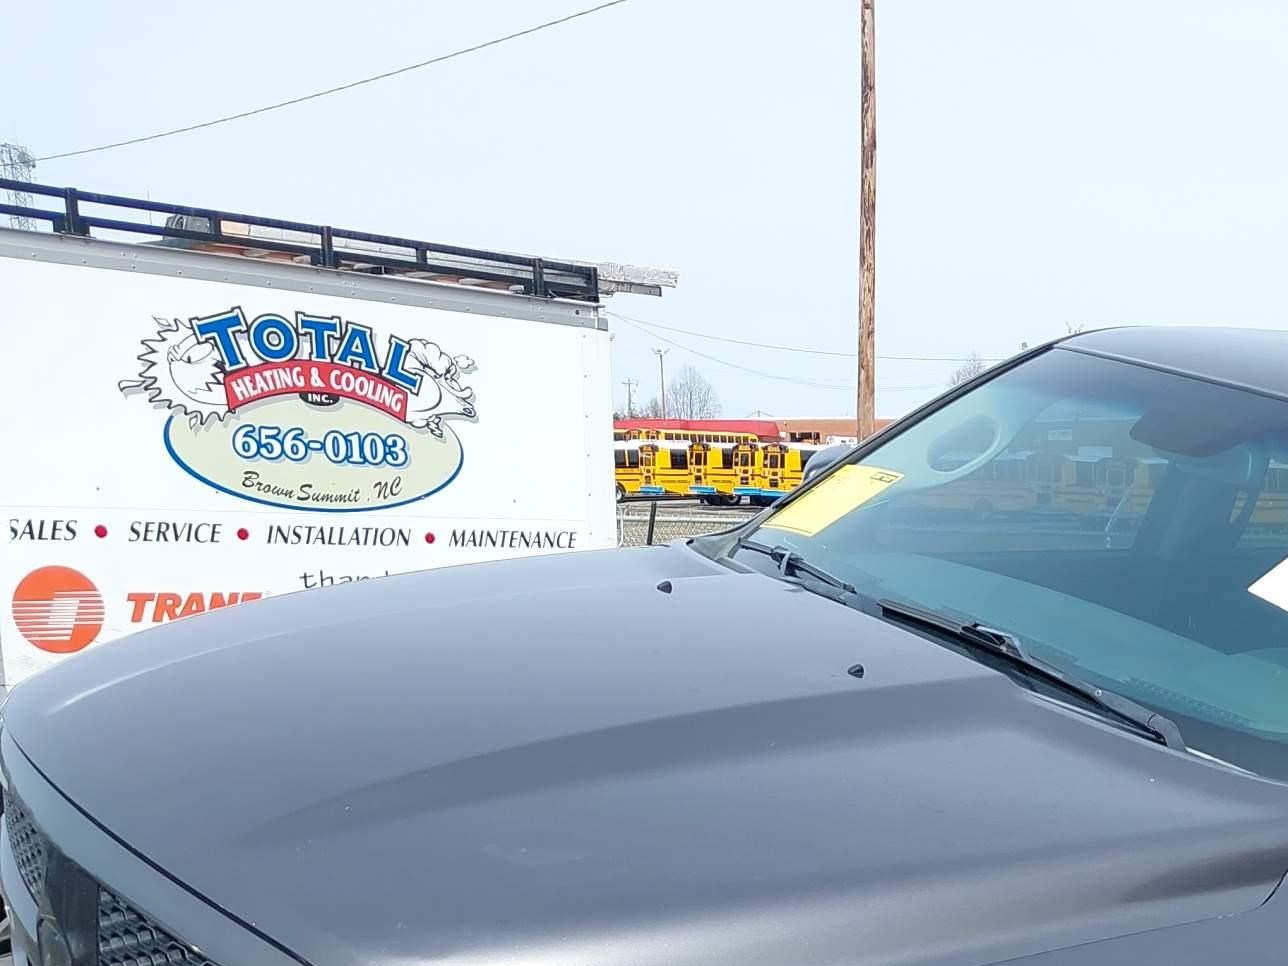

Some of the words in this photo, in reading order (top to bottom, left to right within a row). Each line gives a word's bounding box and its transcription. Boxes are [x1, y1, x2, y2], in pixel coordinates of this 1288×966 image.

[189, 306, 423, 396] TOTAL
[230, 367, 305, 401] HEATING
[330, 371, 402, 412] COOLING
[308, 393, 333, 404] INC.
[233, 425, 408, 466] 656-0103
[241, 471, 294, 498] Brown
[9, 518, 78, 541] SALES
[128, 521, 222, 543] SERVICE
[266, 525, 411, 546] INSTALLATION
[449, 529, 577, 549] MAINTENANCE
